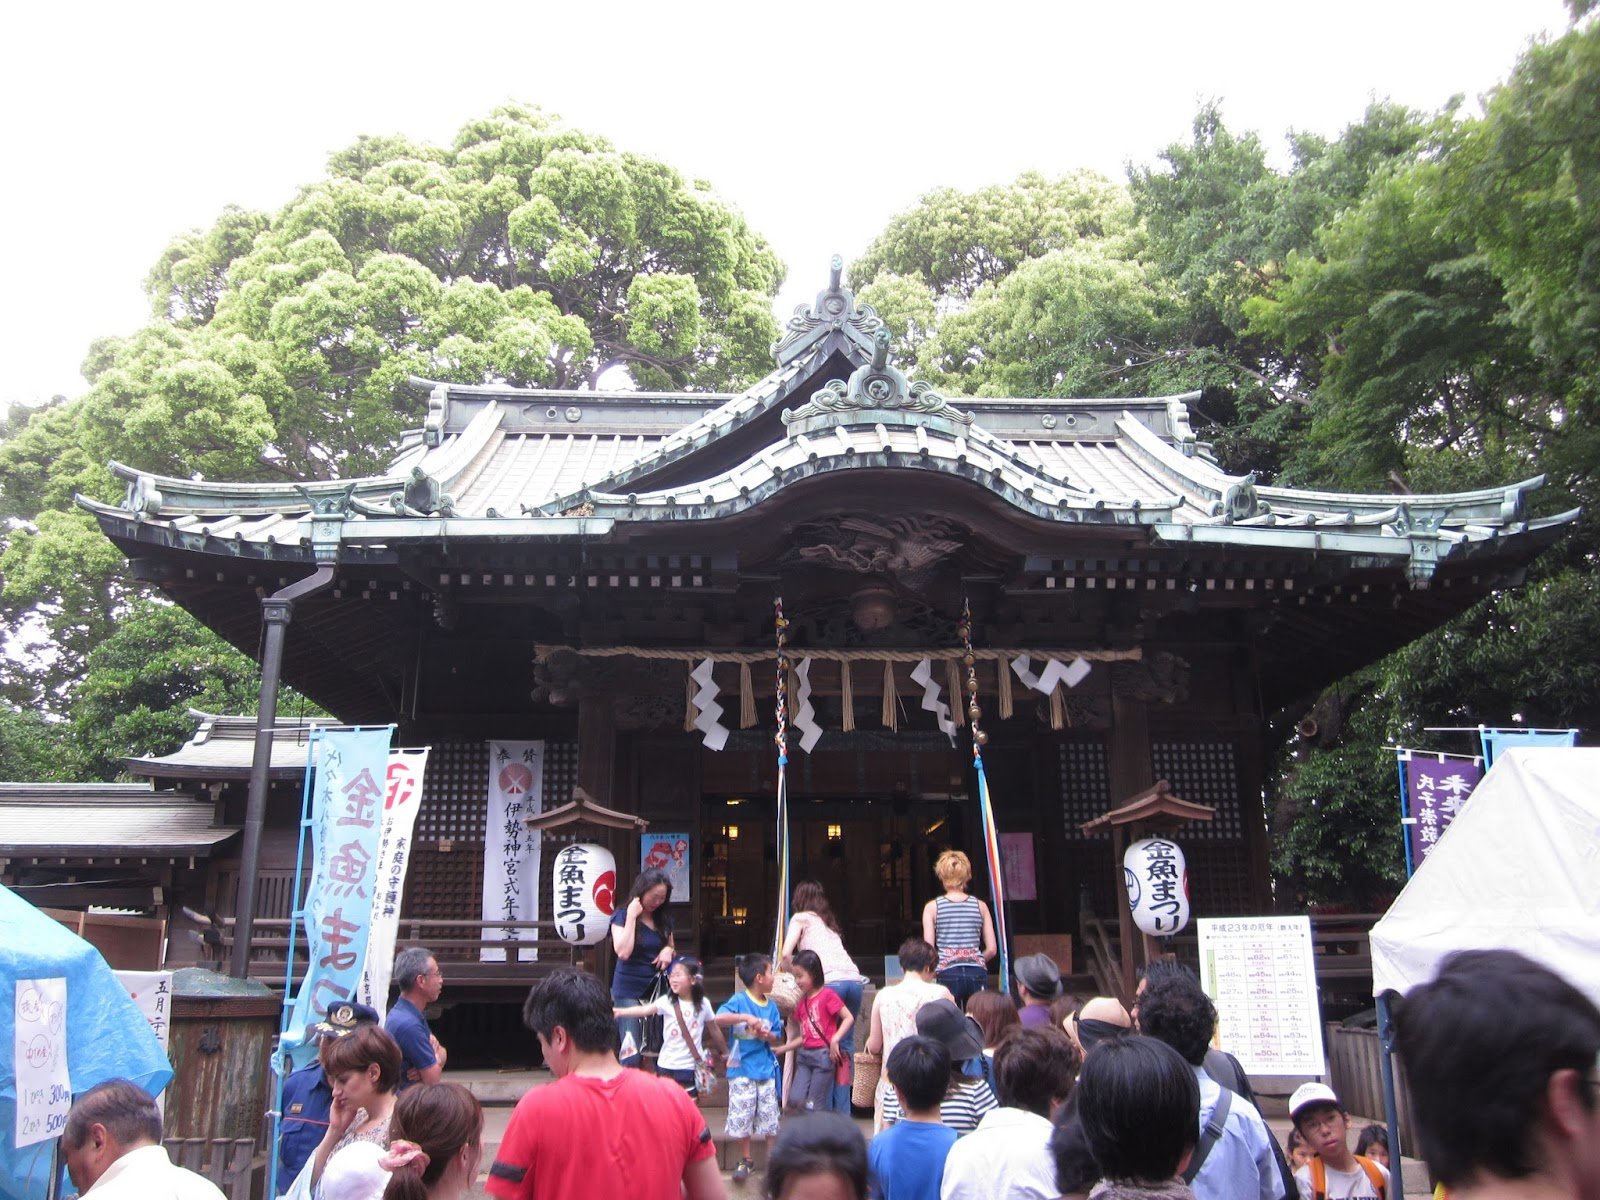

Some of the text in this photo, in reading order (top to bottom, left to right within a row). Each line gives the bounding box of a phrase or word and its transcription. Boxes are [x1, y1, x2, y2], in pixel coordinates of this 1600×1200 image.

[525, 795, 536, 855] 平成五年
[382, 837, 407, 918] 家庭の守護神
[556, 846, 589, 942] 金魚まつり
[1141, 840, 1181, 933] 金魚まつり
